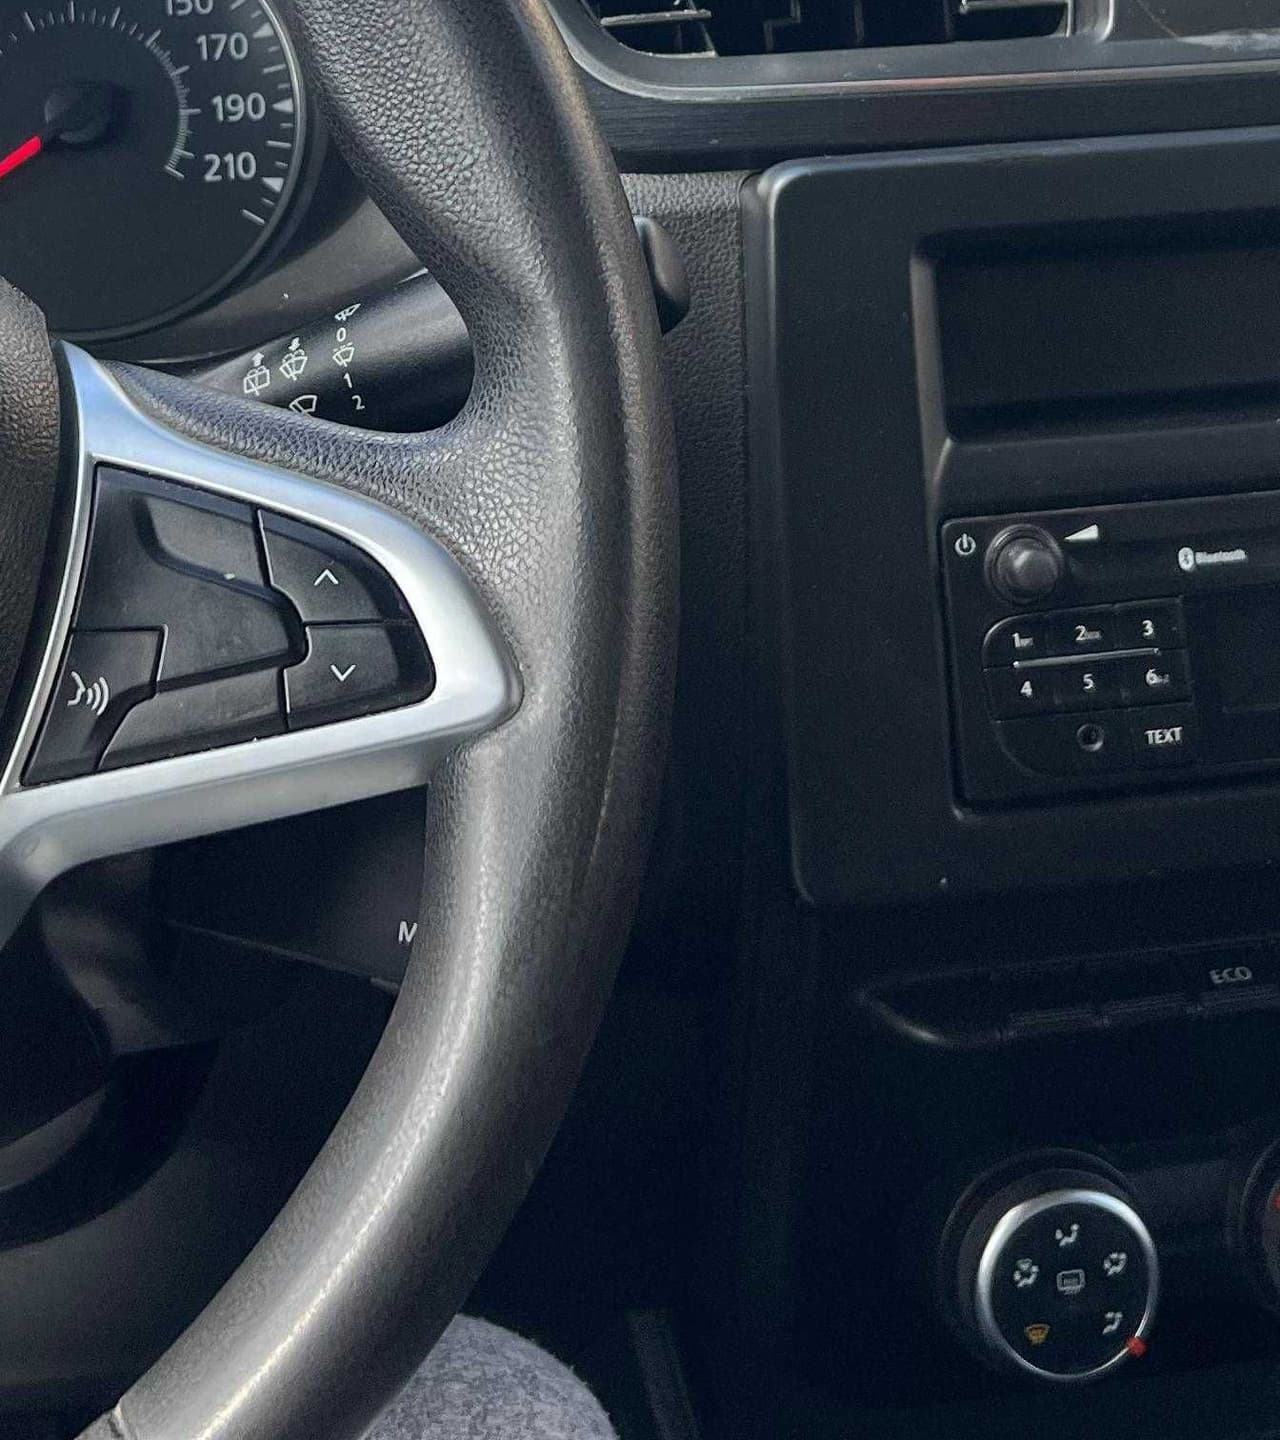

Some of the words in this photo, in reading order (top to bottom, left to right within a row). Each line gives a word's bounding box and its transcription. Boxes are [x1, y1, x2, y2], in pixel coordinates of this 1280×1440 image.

[196, 31, 249, 61] 170
[212, 92, 266, 122] 190
[204, 151, 257, 182] 210
[343, 371, 353, 388] 1
[351, 393, 366, 411] 2
[1142, 619, 1154, 637] 3
[1020, 680, 1033, 697] 4
[1083, 673, 1095, 690] 5
[1145, 726, 1182, 745] TEXT
[1208, 965, 1254, 985] ECO
